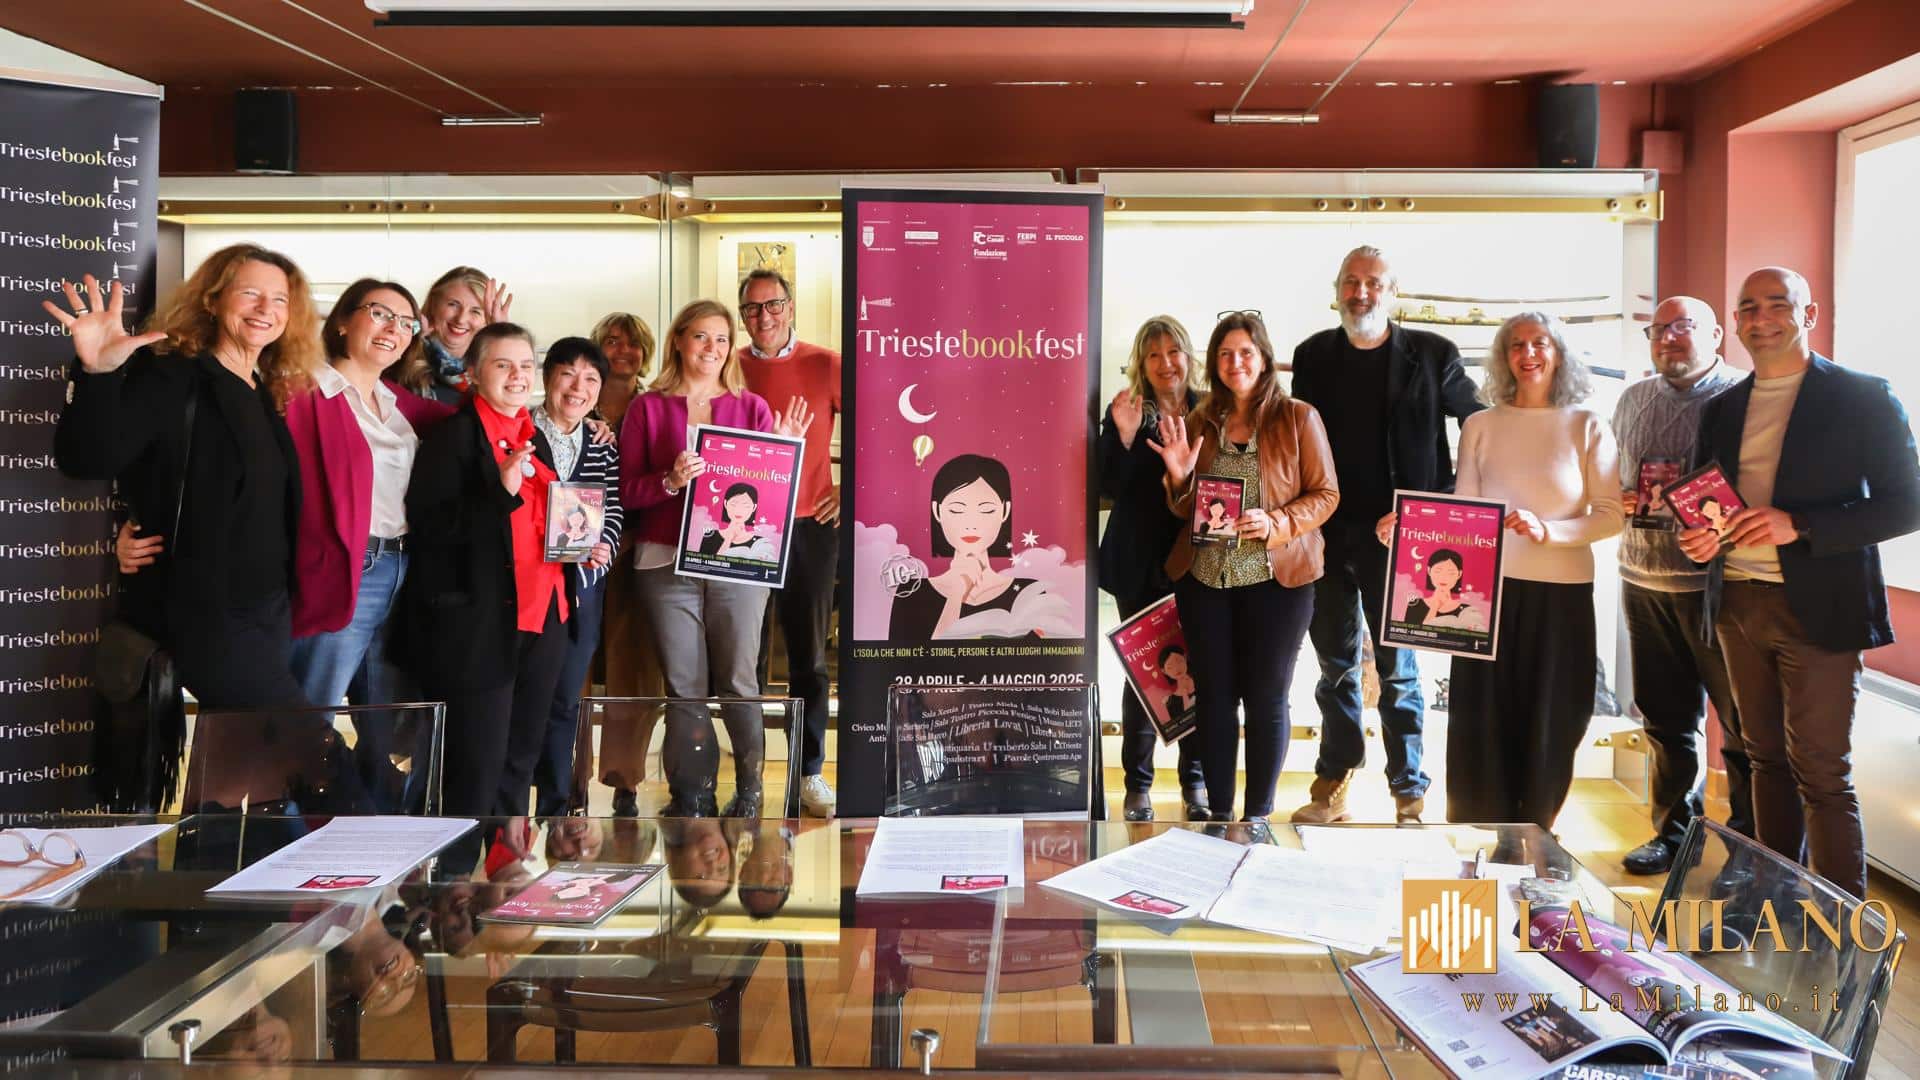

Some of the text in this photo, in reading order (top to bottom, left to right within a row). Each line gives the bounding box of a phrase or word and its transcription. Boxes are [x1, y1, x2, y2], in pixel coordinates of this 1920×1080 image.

[0, 142, 138, 169] Triestebookfest
[0, 186, 137, 212] Triestebookfest
[0, 230, 137, 254] Triestebookfest
[856, 328, 1086, 359] Triestebookfest
[853, 648, 879, 658] L'ISOLA
[880, 648, 895, 657] CHE
[896, 648, 911, 657] NON
[930, 647, 956, 658] STORIE,
[958, 647, 989, 657] PERSONE
[990, 647, 995, 656] E
[996, 647, 1015, 656] ALTRI
[1016, 647, 1041, 656] LUOGHI
[1042, 646, 1085, 656] IMMAGINARI
[917, 675, 965, 693] APRILE
[851, 724, 875, 732] Civico
